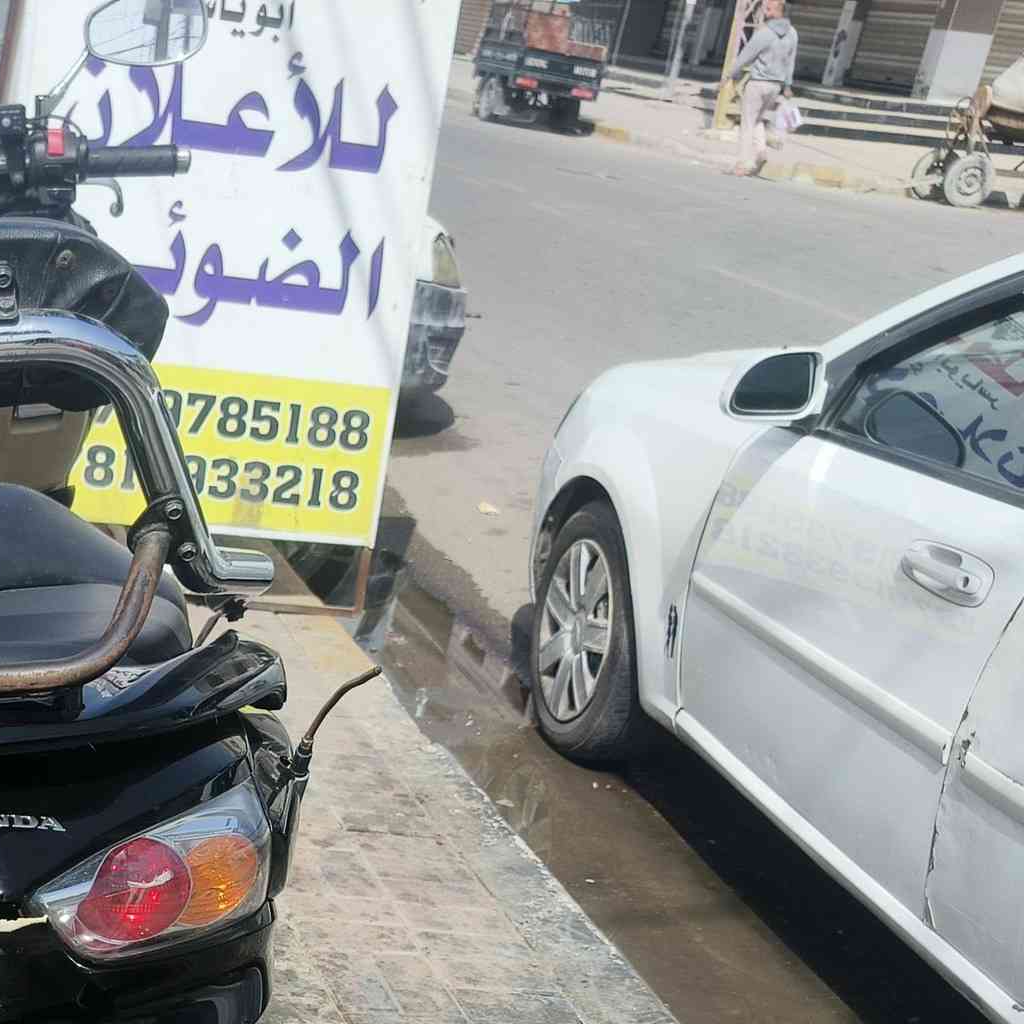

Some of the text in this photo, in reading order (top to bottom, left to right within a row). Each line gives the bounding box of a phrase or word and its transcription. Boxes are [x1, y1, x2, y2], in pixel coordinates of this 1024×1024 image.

[131, 200, 385, 327] الضوئ
[95, 388, 371, 450] 9785188
[84, 443, 360, 511] 81933218
